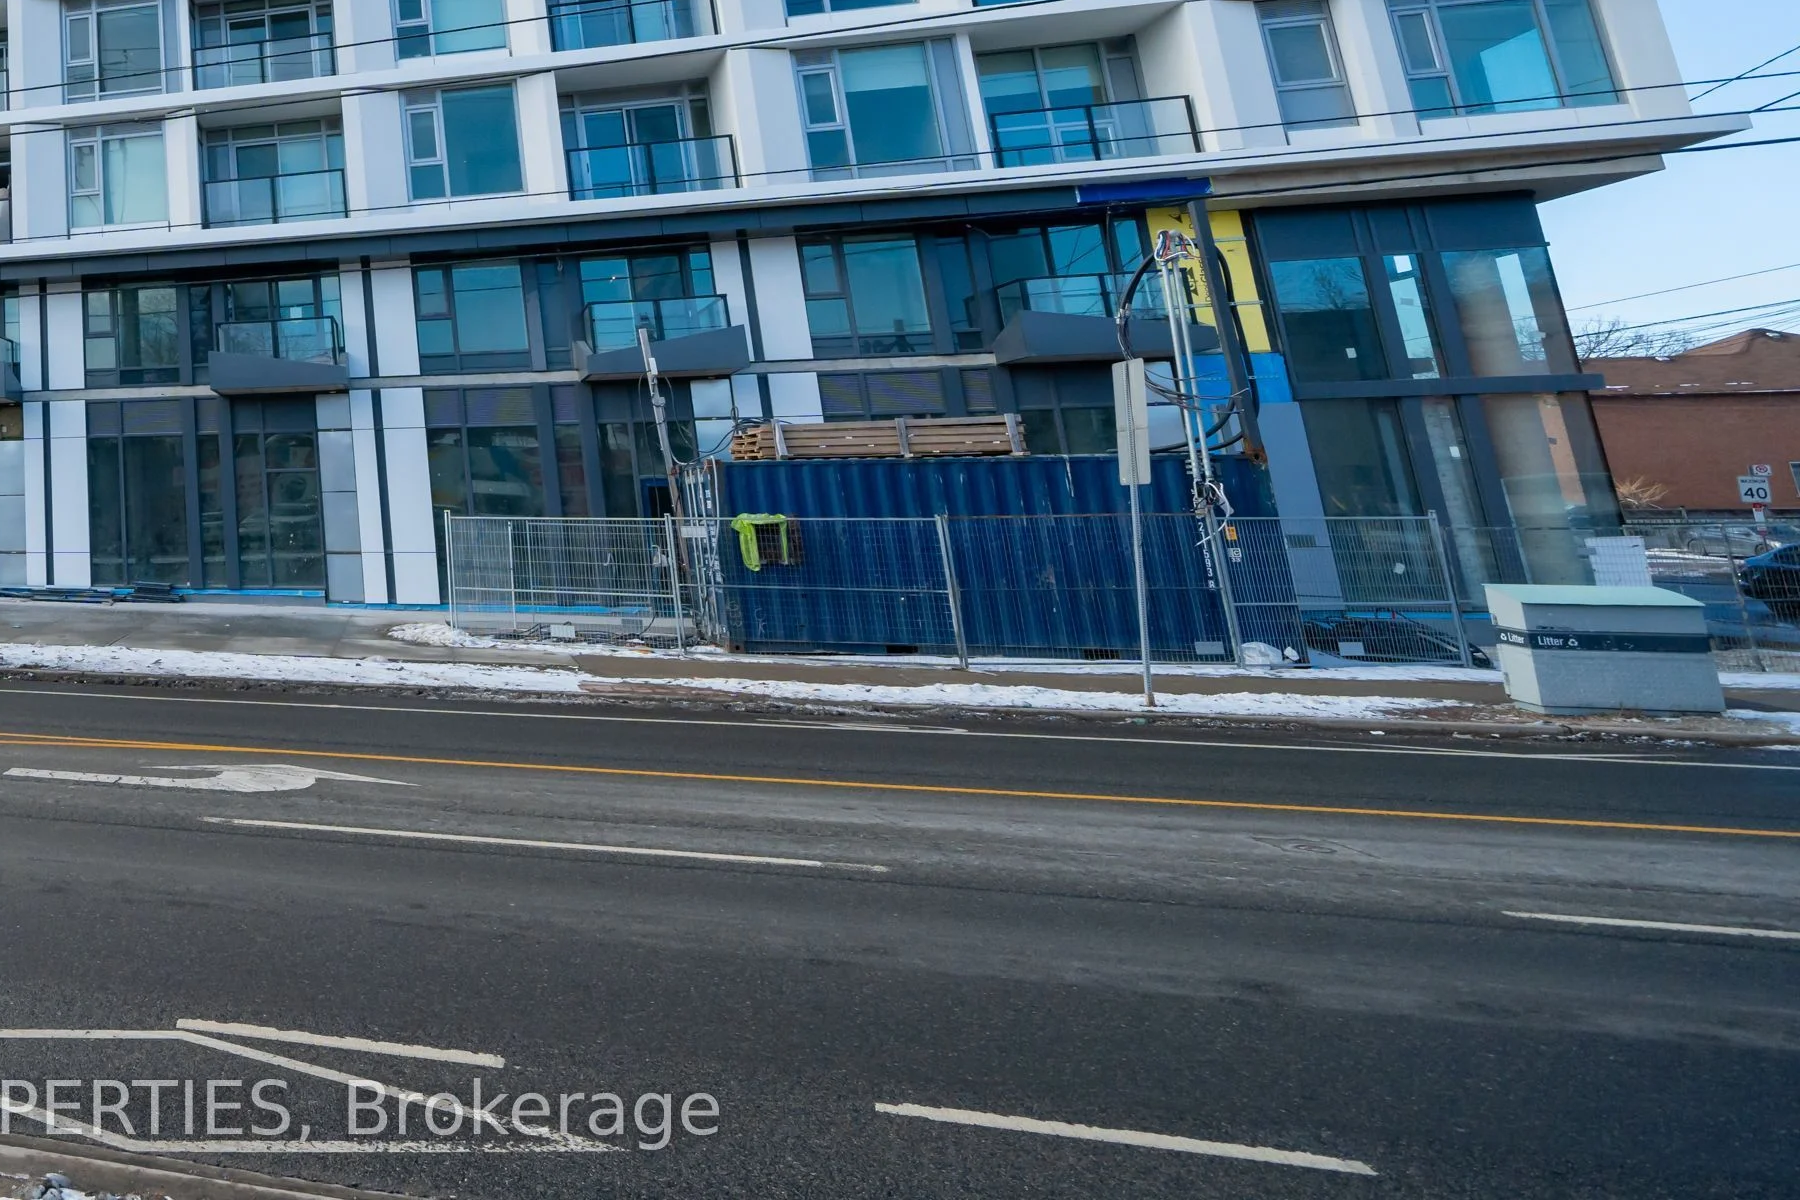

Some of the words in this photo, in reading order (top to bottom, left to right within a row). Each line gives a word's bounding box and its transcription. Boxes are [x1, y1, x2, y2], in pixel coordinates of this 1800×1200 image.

[1744, 487, 1768, 499] 40
[1507, 632, 1525, 644] Litter
[1537, 635, 1564, 646] Litter
